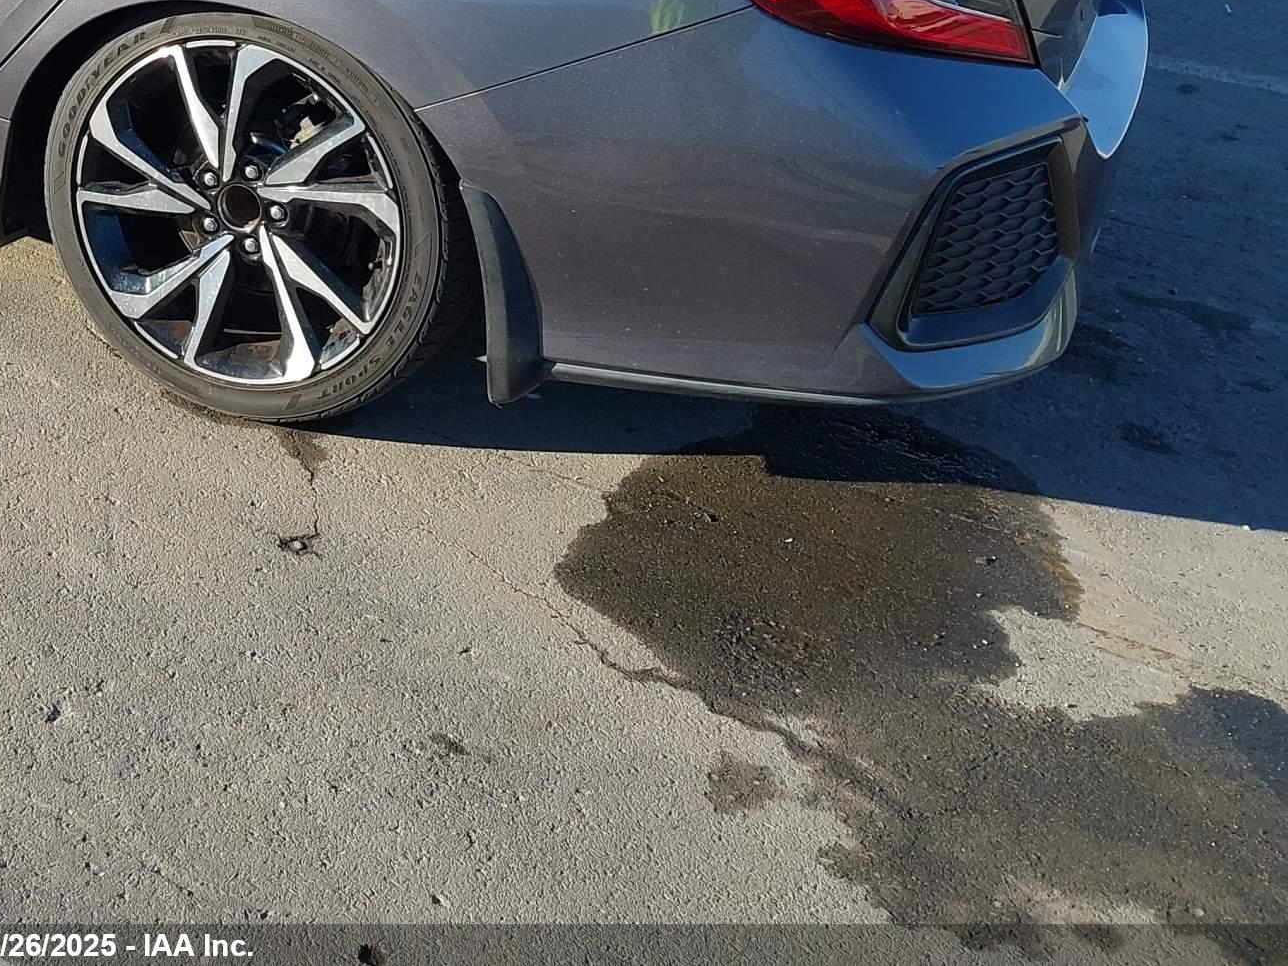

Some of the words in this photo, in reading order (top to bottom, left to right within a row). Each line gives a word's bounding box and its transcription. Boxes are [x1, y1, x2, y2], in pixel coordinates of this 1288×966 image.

[58, 31, 148, 158] GOODYEAR
[385, 272, 423, 348] EAGLE
[317, 355, 383, 400] SPORT
